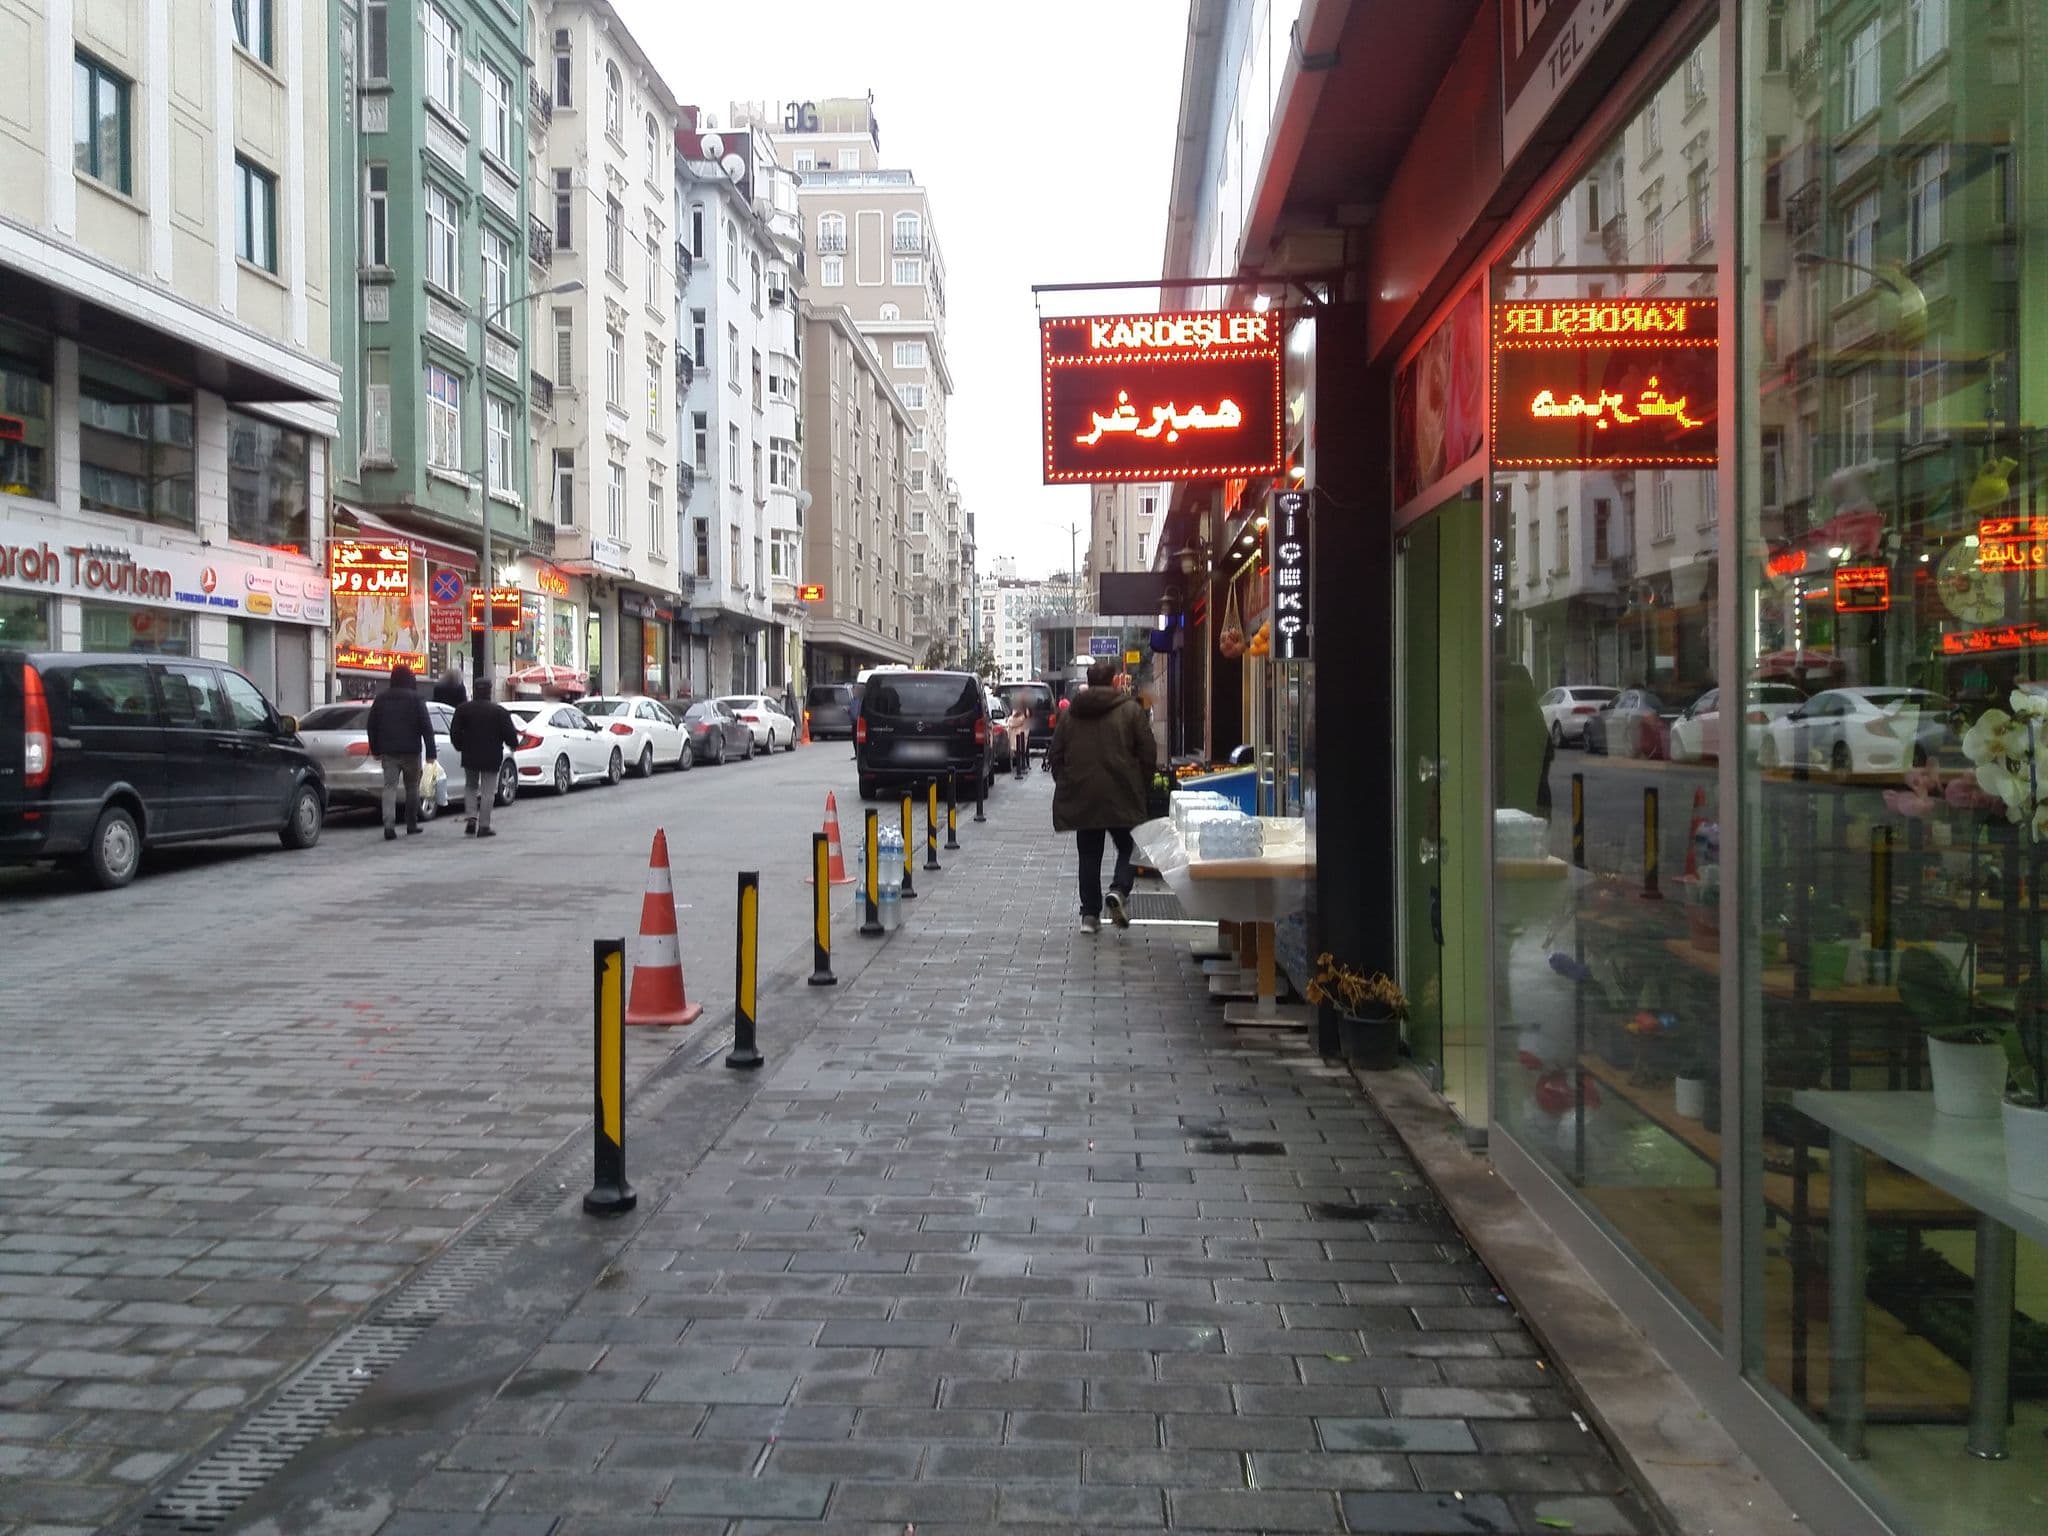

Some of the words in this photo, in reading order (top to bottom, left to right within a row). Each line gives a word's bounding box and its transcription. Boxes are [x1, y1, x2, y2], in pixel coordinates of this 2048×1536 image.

[1091, 318, 1270, 350] KARDEŞLER
[65, 546, 171, 599] Tourism
[175, 591, 206, 605] TURKISH
[207, 595, 239, 609] AIRLINES
